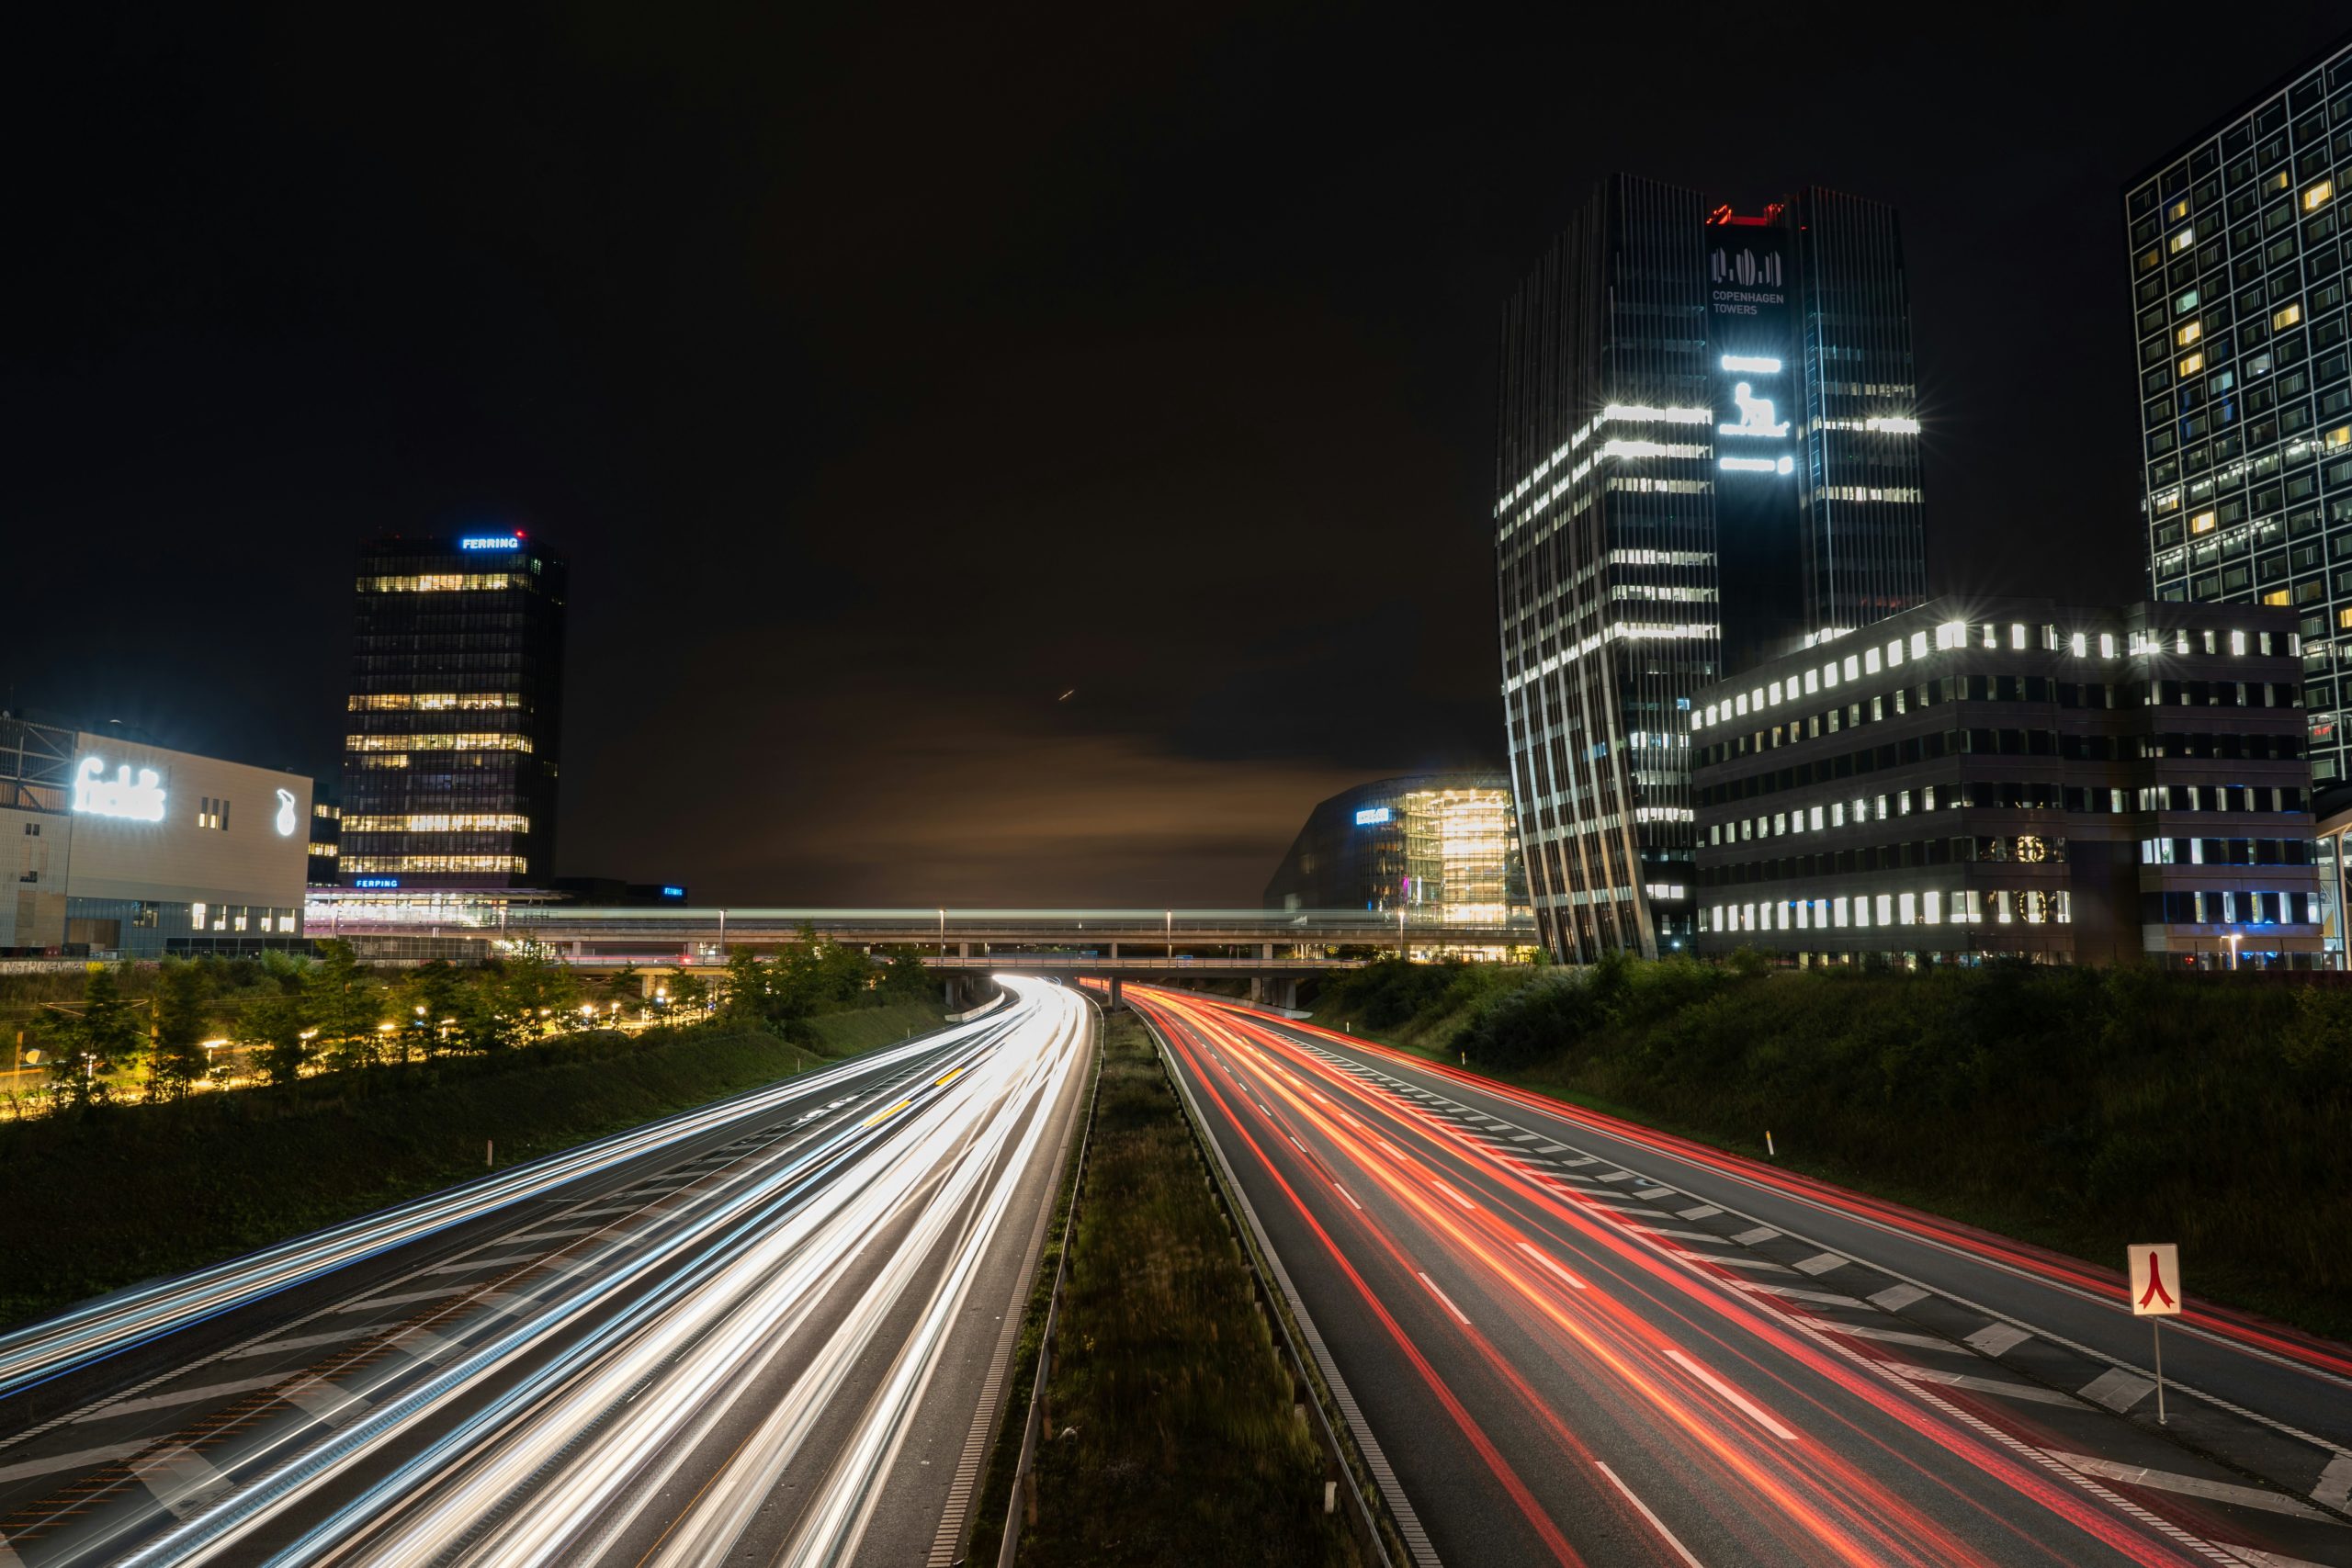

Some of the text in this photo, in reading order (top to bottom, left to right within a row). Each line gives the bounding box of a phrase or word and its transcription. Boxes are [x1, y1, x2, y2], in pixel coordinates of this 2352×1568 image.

[1713, 290, 1784, 304] COPENHAGEN
[1713, 303, 1758, 315] TOWERS
[462, 537, 518, 549] FERRING
